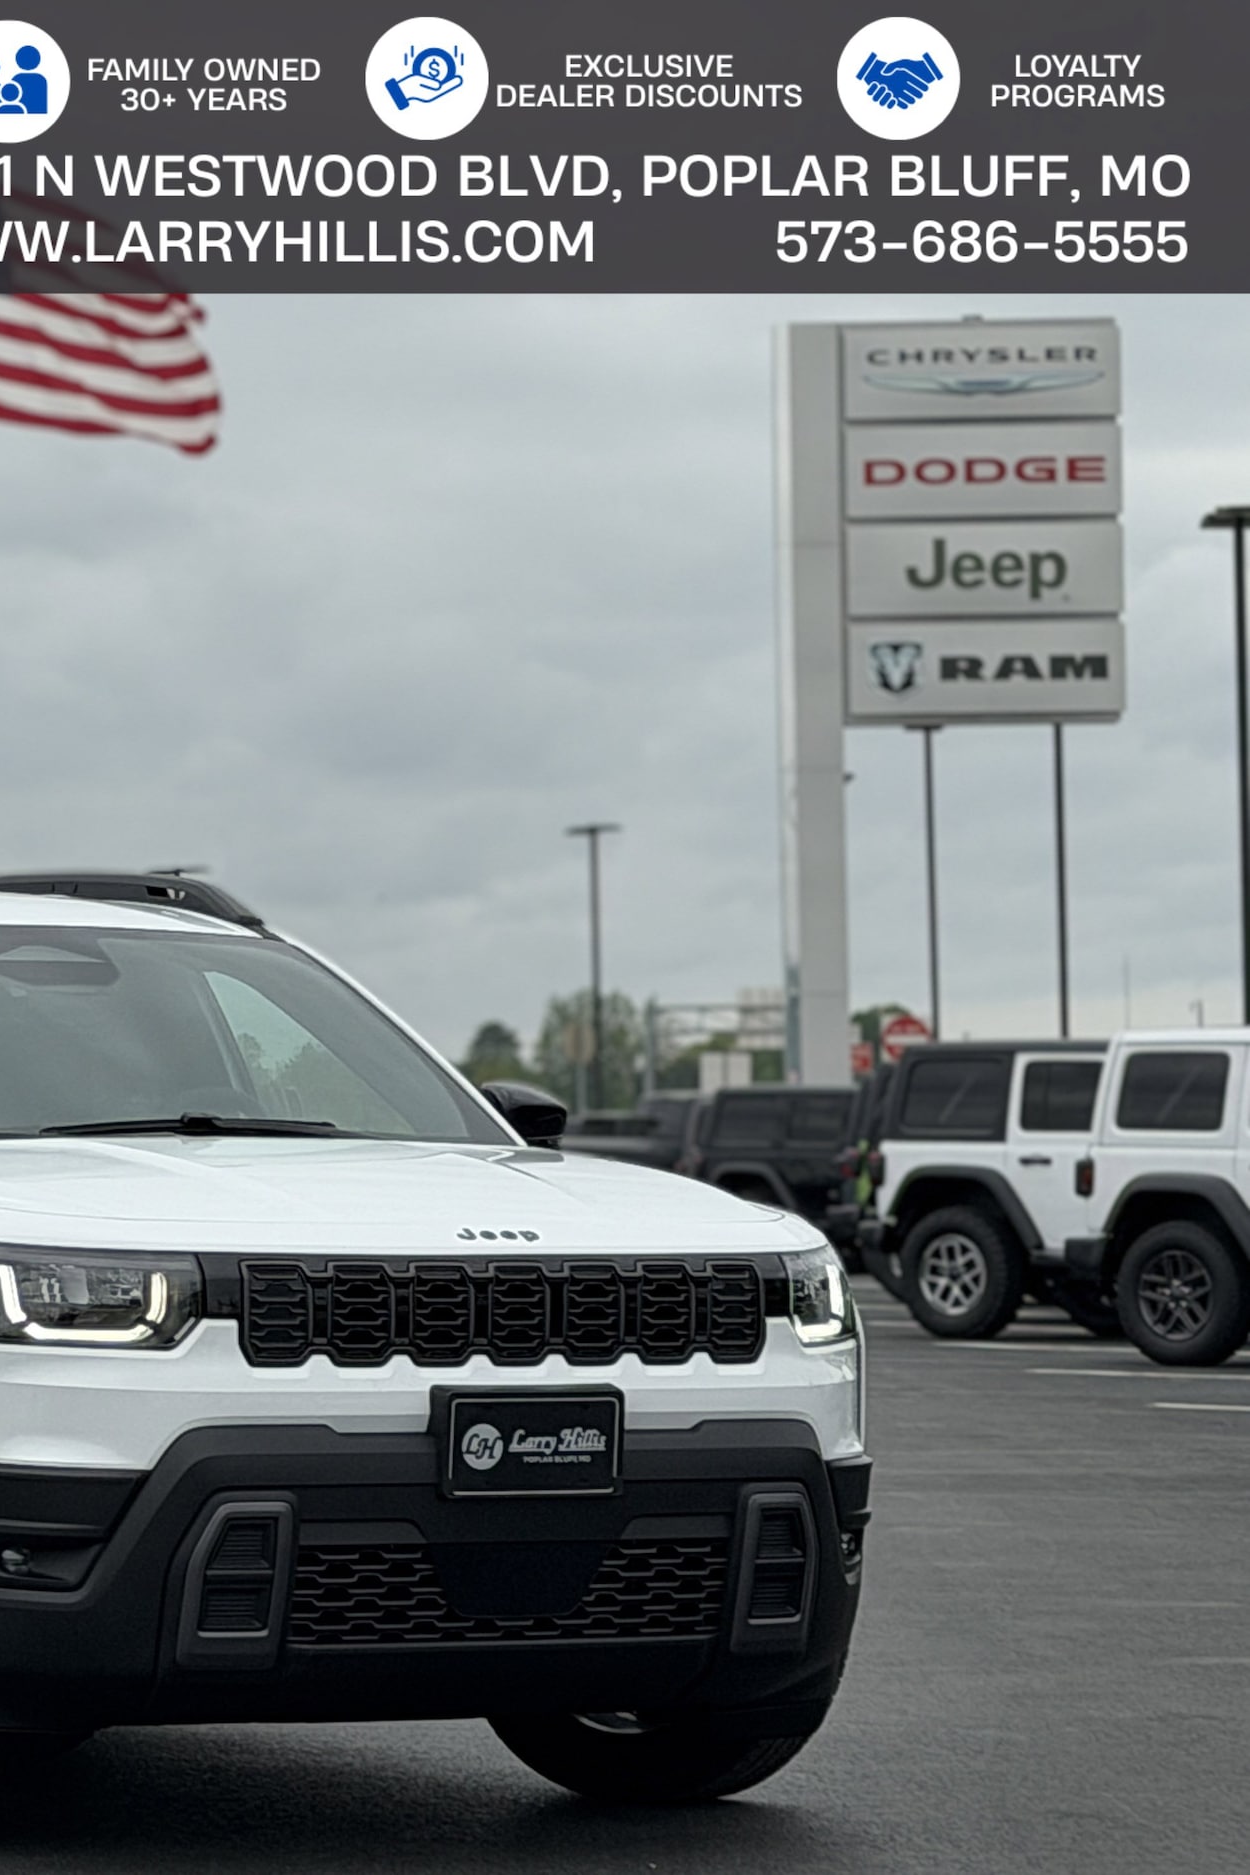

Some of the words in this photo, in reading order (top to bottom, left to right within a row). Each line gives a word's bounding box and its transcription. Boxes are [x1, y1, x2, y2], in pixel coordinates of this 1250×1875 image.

[866, 346, 1098, 365] CHRYSLER
[863, 456, 1106, 486] DODGE
[905, 538, 1068, 601] Jeep
[939, 654, 1109, 681] RAM
[456, 1227, 540, 1242] Jeep
[508, 1429, 557, 1455] Larry
[558, 1427, 607, 1452] Hillis
